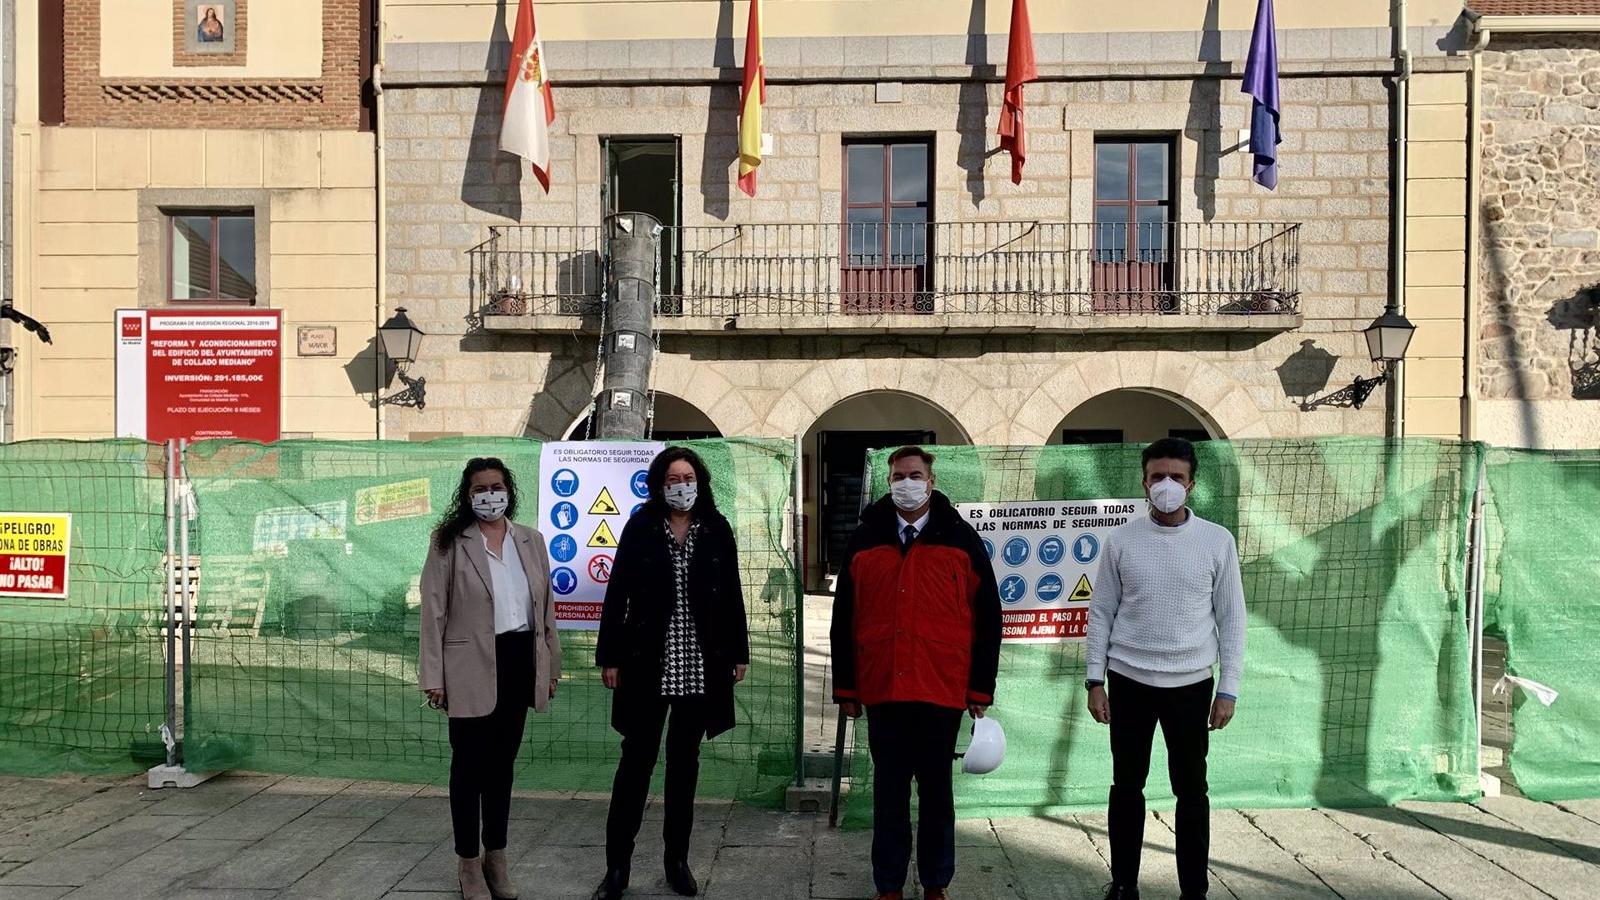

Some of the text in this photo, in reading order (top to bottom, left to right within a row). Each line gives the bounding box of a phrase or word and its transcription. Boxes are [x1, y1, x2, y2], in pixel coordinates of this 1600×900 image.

[165, 373, 212, 382] INVERSIÓN:
[970, 504, 1135, 518] ES OBLIGATORIO SEGUIR TODAS
[976, 522, 996, 531] LAS
[1002, 520, 1047, 531] NORMAS
[1053, 520, 1066, 529] DE
[18, 539, 29, 551] DE
[33, 540, 63, 552] OBRAS
[9, 557, 45, 571] ¡ALTO!
[0, 574, 53, 589] NO PASAR
[1002, 613, 1035, 623] OHIBIDO
[1039, 613, 1048, 622] EL
[1052, 612, 1072, 622] PASO
[1076, 612, 1080, 621] A
[1002, 626, 1027, 635] RSONA
[1031, 625, 1056, 635] AJENA
[1060, 625, 1065, 634] A
[1069, 625, 1079, 634] LA
